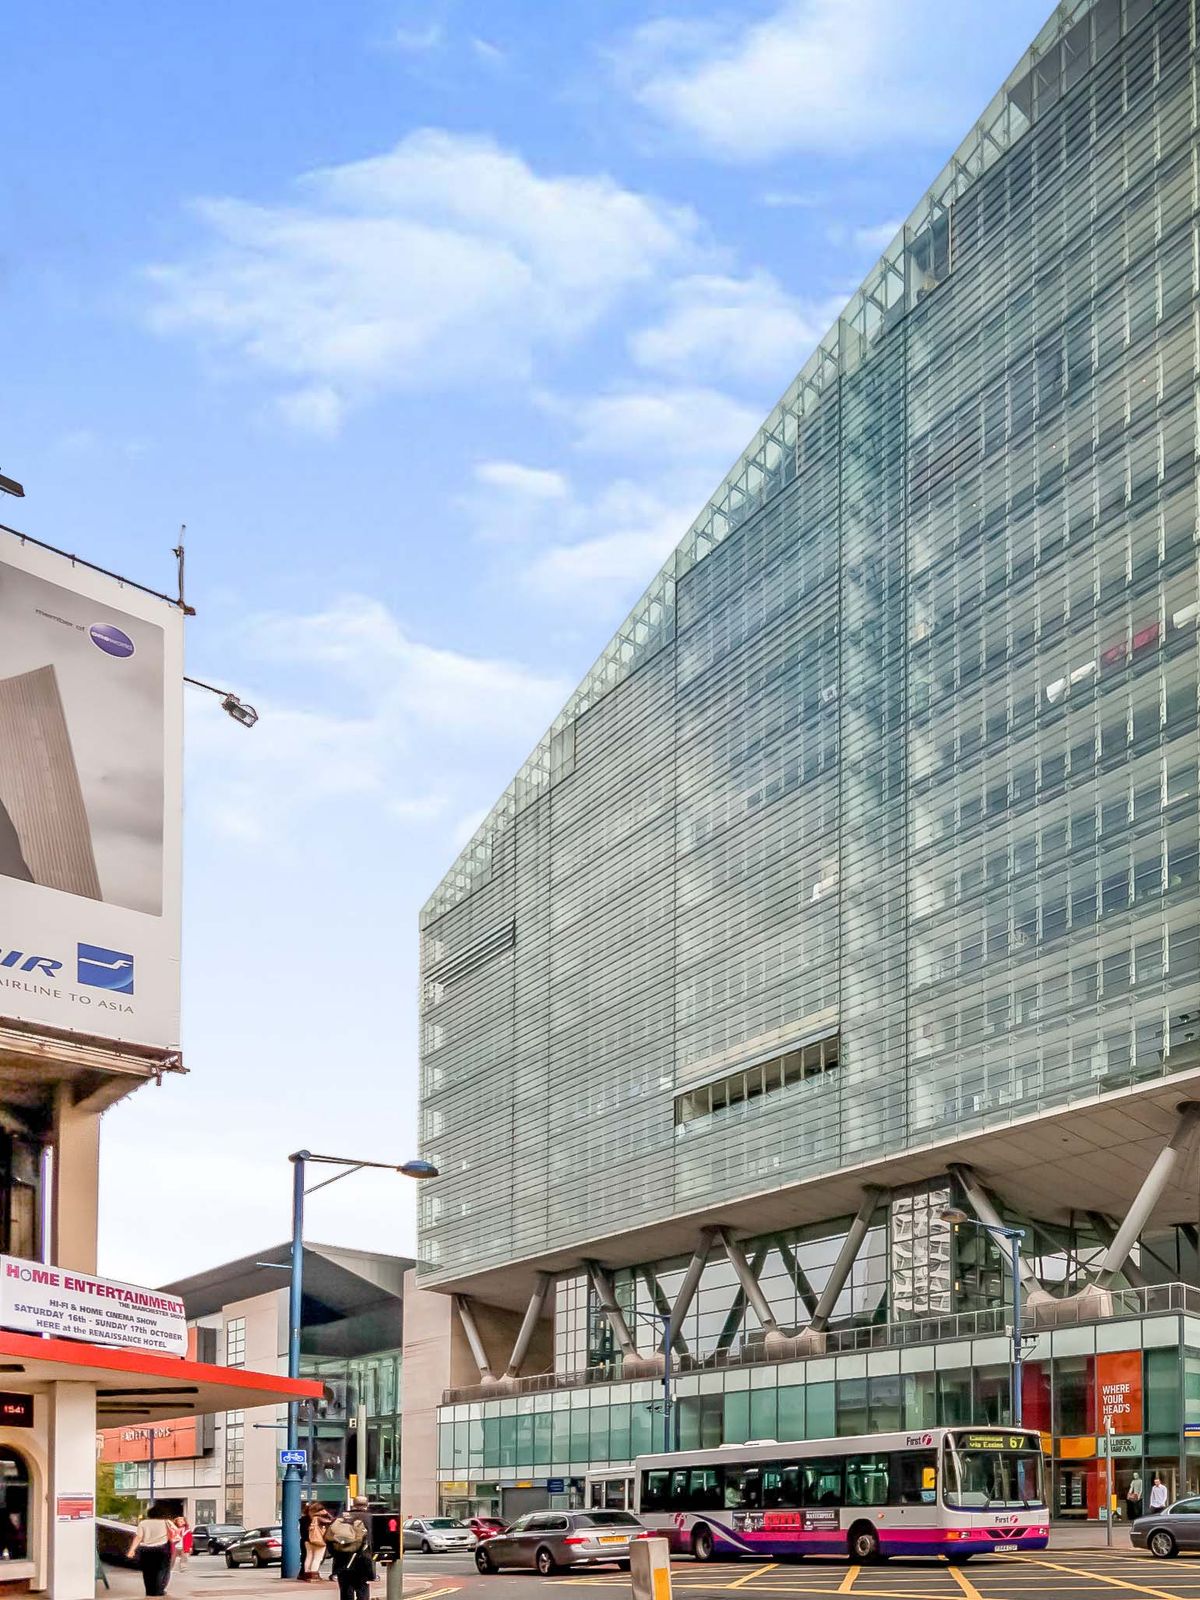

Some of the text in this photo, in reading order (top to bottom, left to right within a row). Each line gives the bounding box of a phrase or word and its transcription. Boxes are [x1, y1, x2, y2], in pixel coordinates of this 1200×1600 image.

[0, 949, 63, 977] IR
[69, 993, 91, 1004] TO
[98, 1000, 134, 1014] ASIA
[6, 1263, 186, 1314] HOME ENTERTAINMENT
[49, 1300, 158, 1326] HI-FI & HOME CINEMA SHOW
[14, 1304, 64, 1320] SATURDAY
[68, 1314, 86, 1324] 16th
[95, 1319, 128, 1330] SUNDAY
[130, 1325, 148, 1335] 17th
[150, 1329, 183, 1340] OCTOBER
[36, 1319, 167, 1348] HERE at the RENAISSANCE HOTEL
[1102, 1384, 1130, 1394] WHERE
[1102, 1395, 1124, 1405] YOUR
[1103, 1404, 1130, 1414] HEAD'S
[906, 1436, 922, 1446] First
[1010, 1437, 1024, 1448] 67
[995, 1516, 1008, 1524] First
